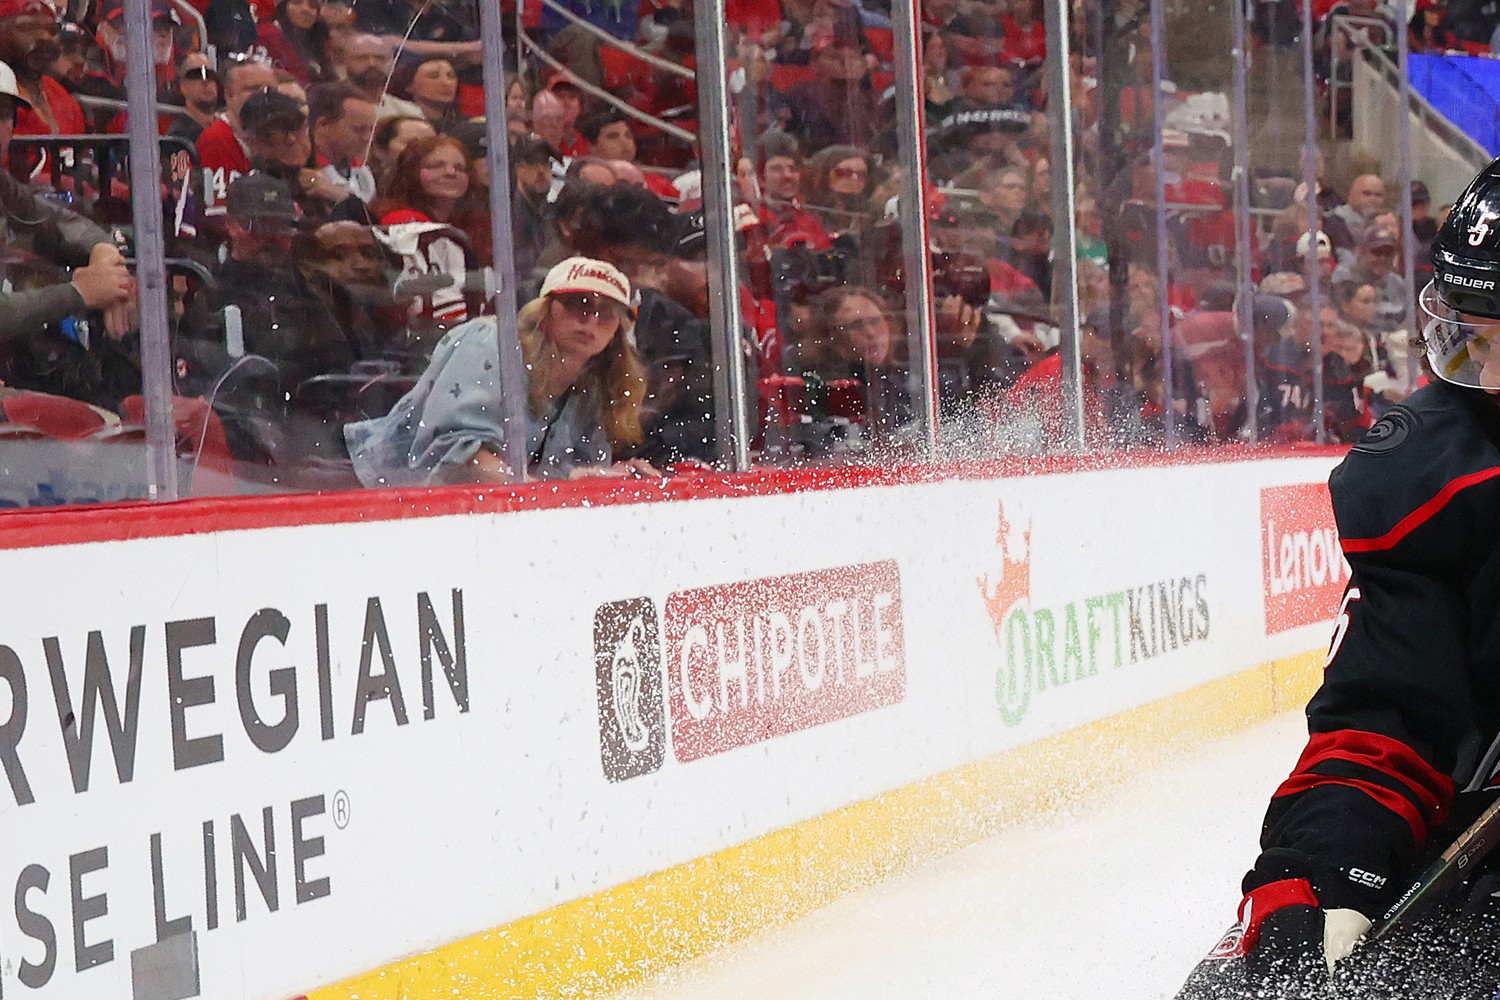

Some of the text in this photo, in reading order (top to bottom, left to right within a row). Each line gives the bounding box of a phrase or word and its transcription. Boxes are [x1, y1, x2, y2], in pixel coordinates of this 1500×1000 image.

[681, 592, 898, 721] CHIPOTLE
[1348, 867, 1387, 886] CCM
[1383, 881, 1422, 920] CHATFIELD
